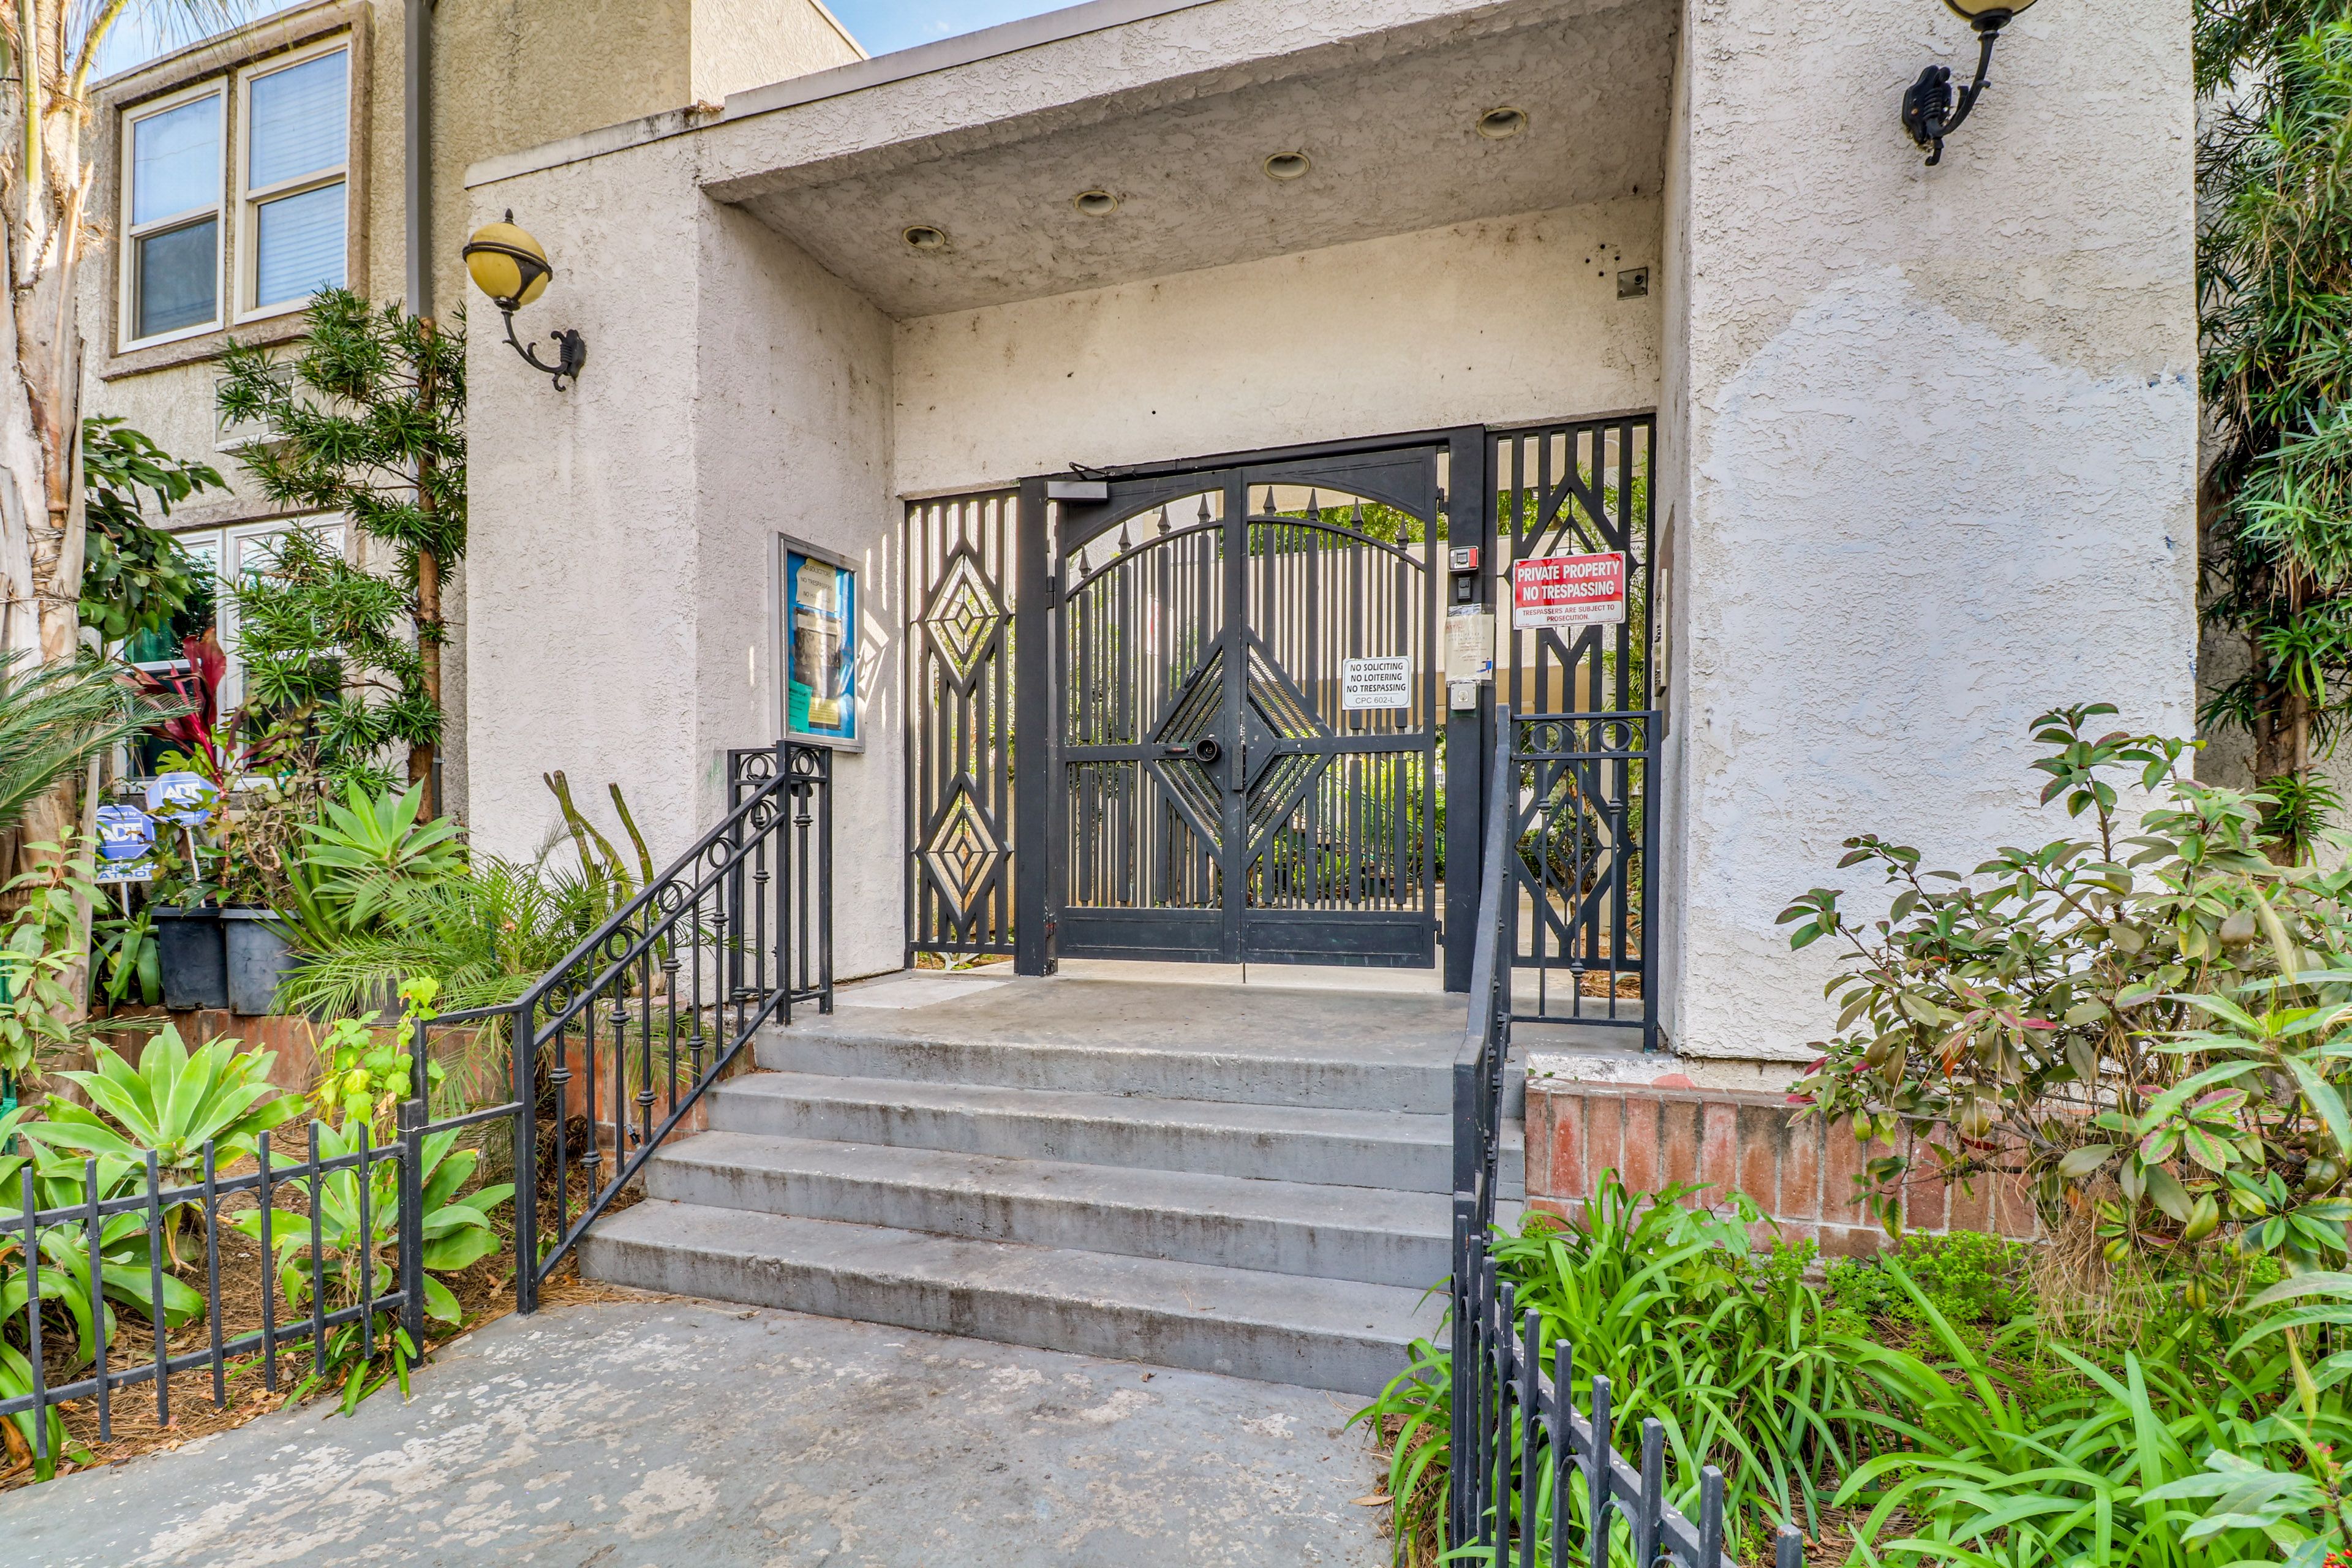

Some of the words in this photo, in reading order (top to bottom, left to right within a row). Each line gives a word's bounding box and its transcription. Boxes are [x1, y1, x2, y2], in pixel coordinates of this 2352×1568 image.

[809, 565, 831, 578] SOLICITORS
[1518, 565, 1559, 582] PRIVATE
[1563, 561, 1619, 579] PROPERTY
[1523, 586, 1539, 601] NO
[1541, 581, 1615, 599] TRESPASSING
[1523, 608, 1562, 616] TRESPASSERS
[1547, 614, 1589, 622] PROSECUTION.
[1363, 662, 1403, 671] SOLICITING
[1364, 673, 1402, 682] LOITERING
[1360, 684, 1406, 692] TRESPASSING
[164, 783, 200, 799] ADT
[99, 823, 142, 842] ADT
